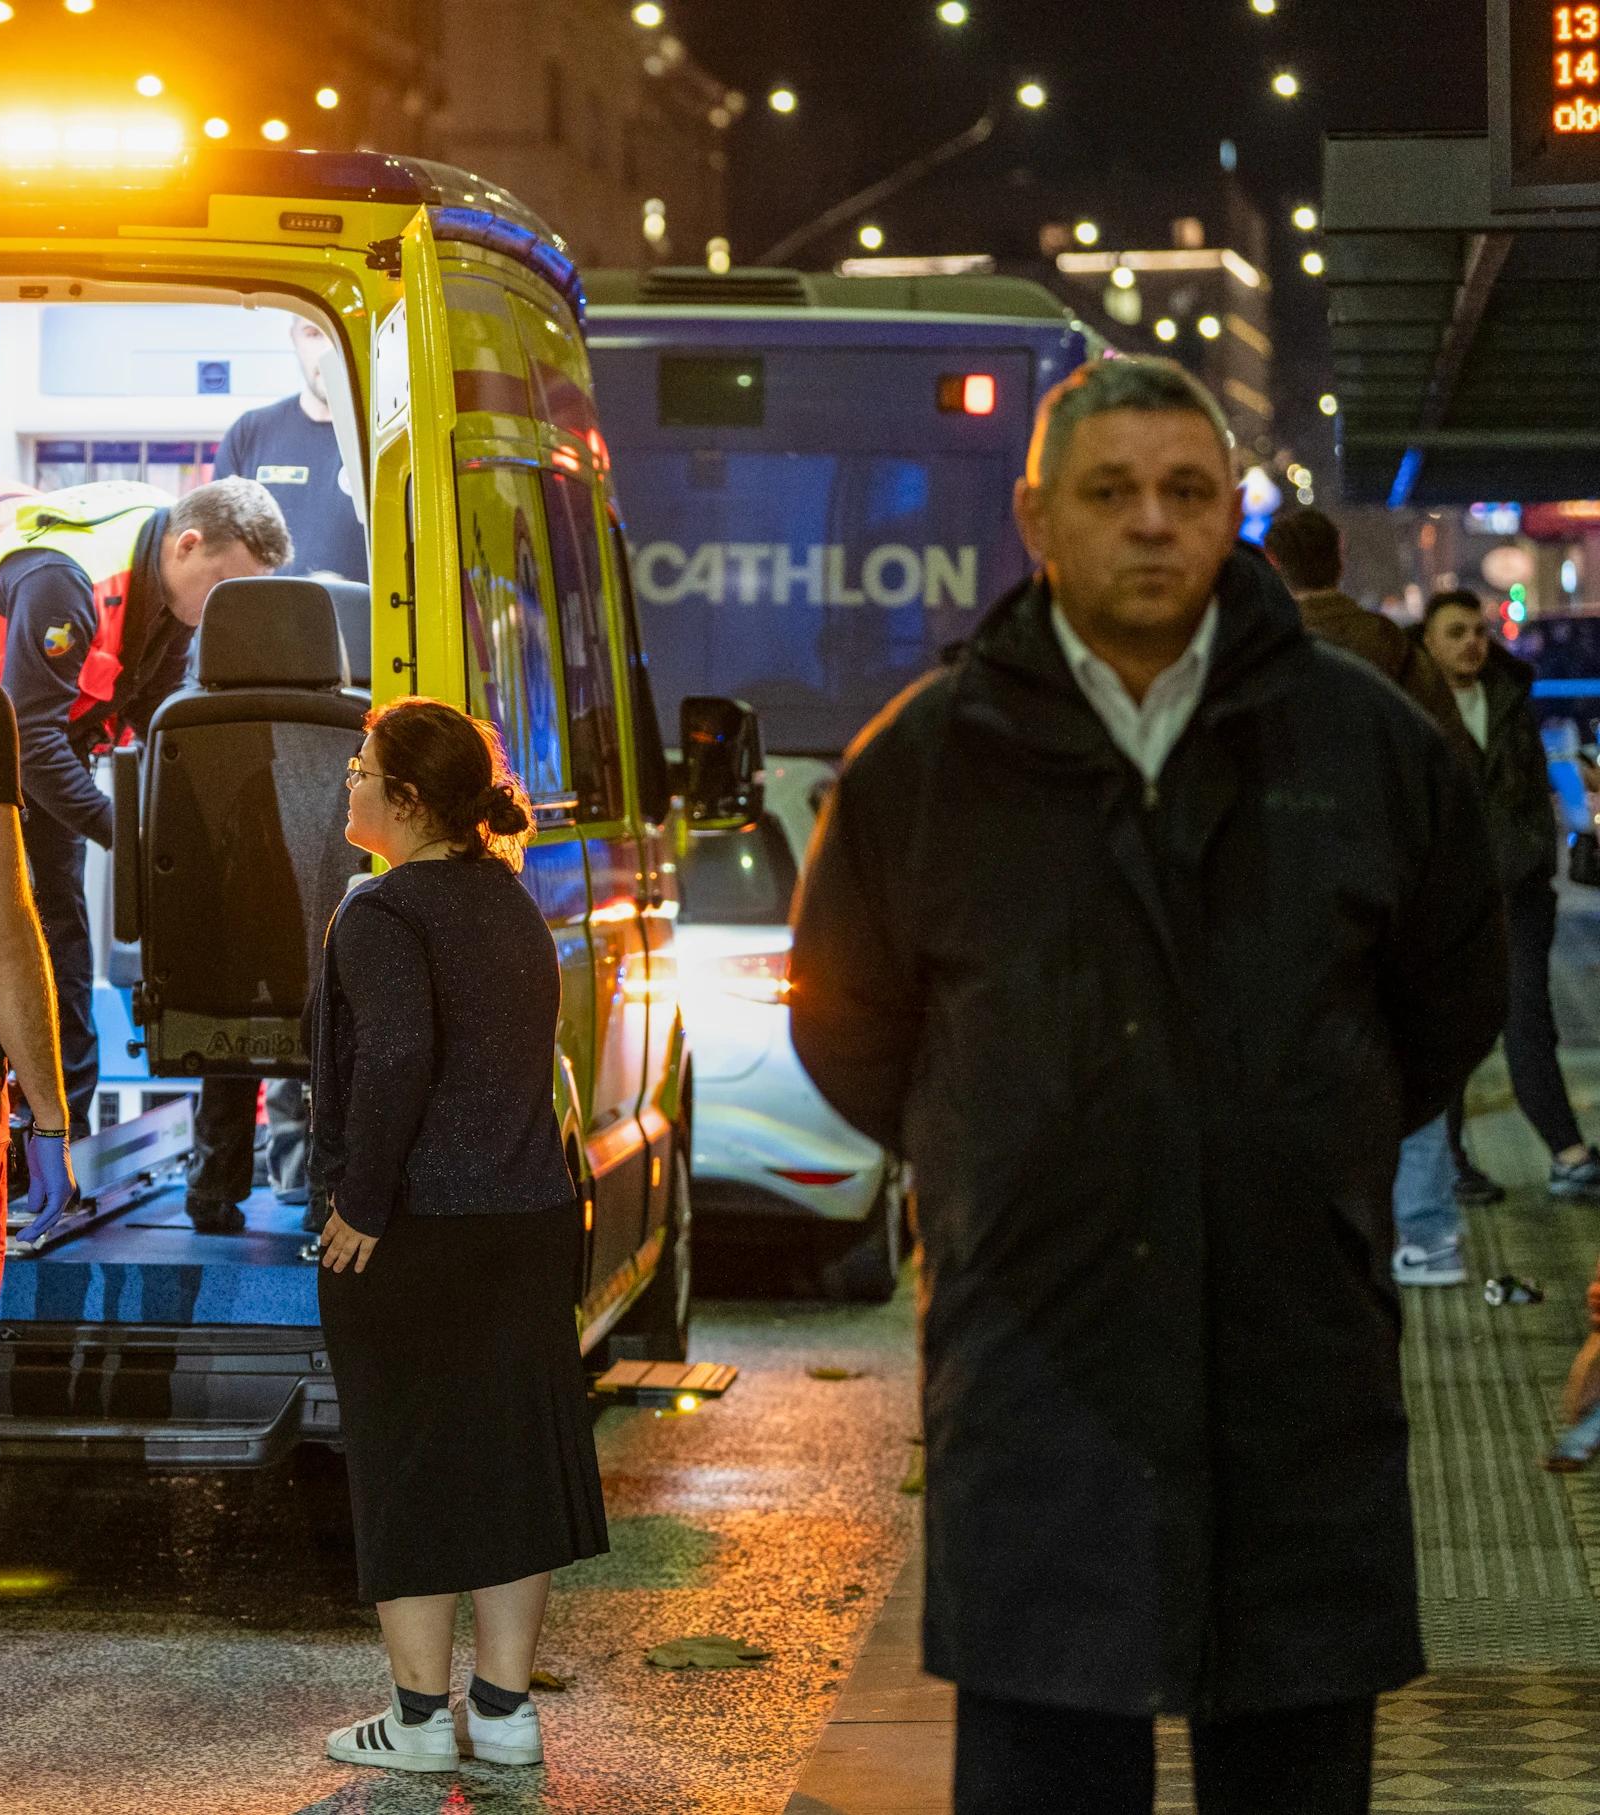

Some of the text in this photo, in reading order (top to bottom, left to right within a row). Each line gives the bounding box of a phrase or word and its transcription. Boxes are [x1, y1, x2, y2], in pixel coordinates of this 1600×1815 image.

[1556, 6, 1599, 41] 13
[1556, 50, 1599, 85] 14
[1554, 97, 1600, 132] ob
[626, 540, 979, 610] CATHLON
[206, 1031, 303, 1056] Amb
